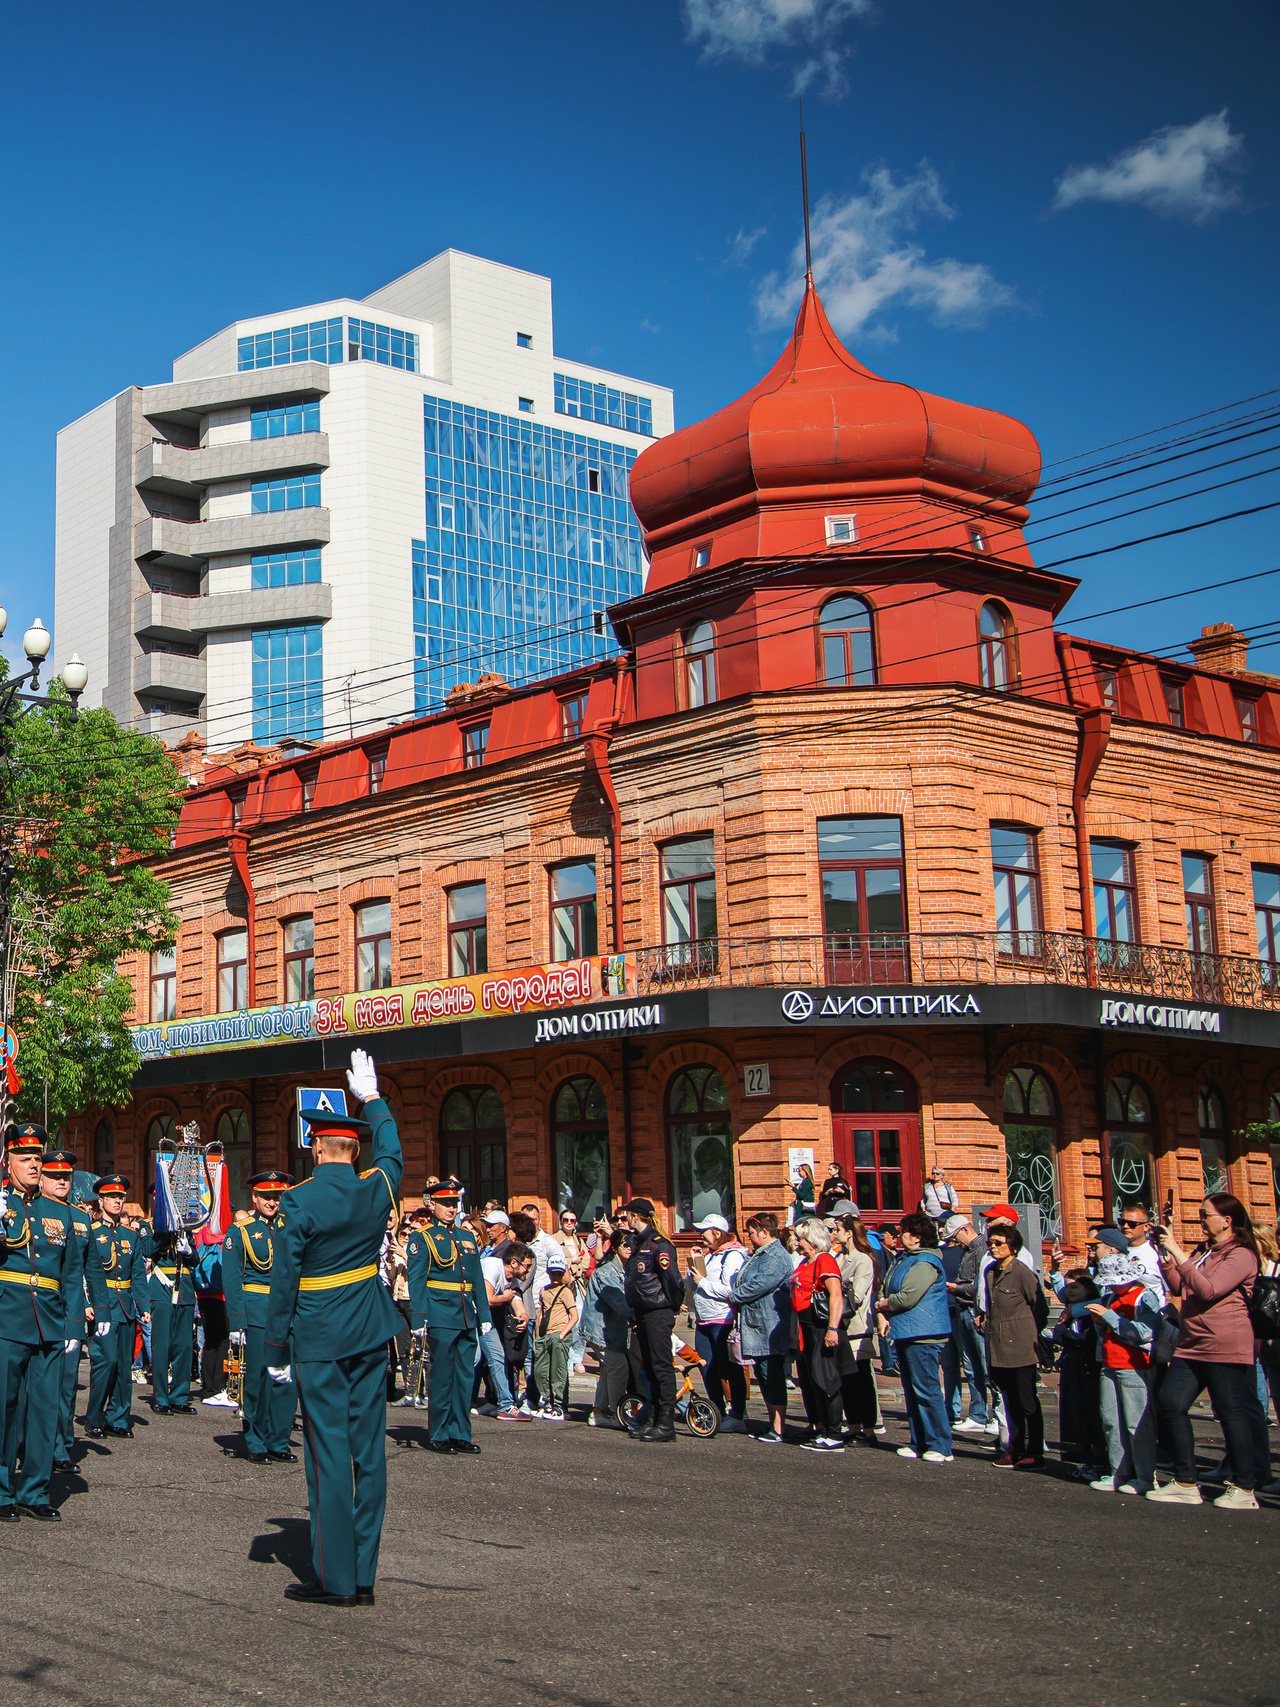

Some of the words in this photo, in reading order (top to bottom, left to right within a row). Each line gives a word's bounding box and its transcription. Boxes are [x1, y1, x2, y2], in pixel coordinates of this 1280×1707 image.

[166, 1011, 250, 1049] ЛЮБИМЫЙ
[252, 1006, 311, 1038] ГОРОД!
[317, 996, 348, 1034] 31
[355, 997, 403, 1029] мая
[412, 984, 475, 1023] день
[482, 960, 591, 1013] города!
[820, 994, 981, 1015] ДИОПТРИКА
[1100, 999, 1145, 1026] ДОМ
[1146, 1005, 1220, 1033] ОПТИКИ
[535, 1015, 579, 1042] ДОМ
[580, 1004, 661, 1032] ОПТИКИ
[748, 1068, 763, 1091] 22
